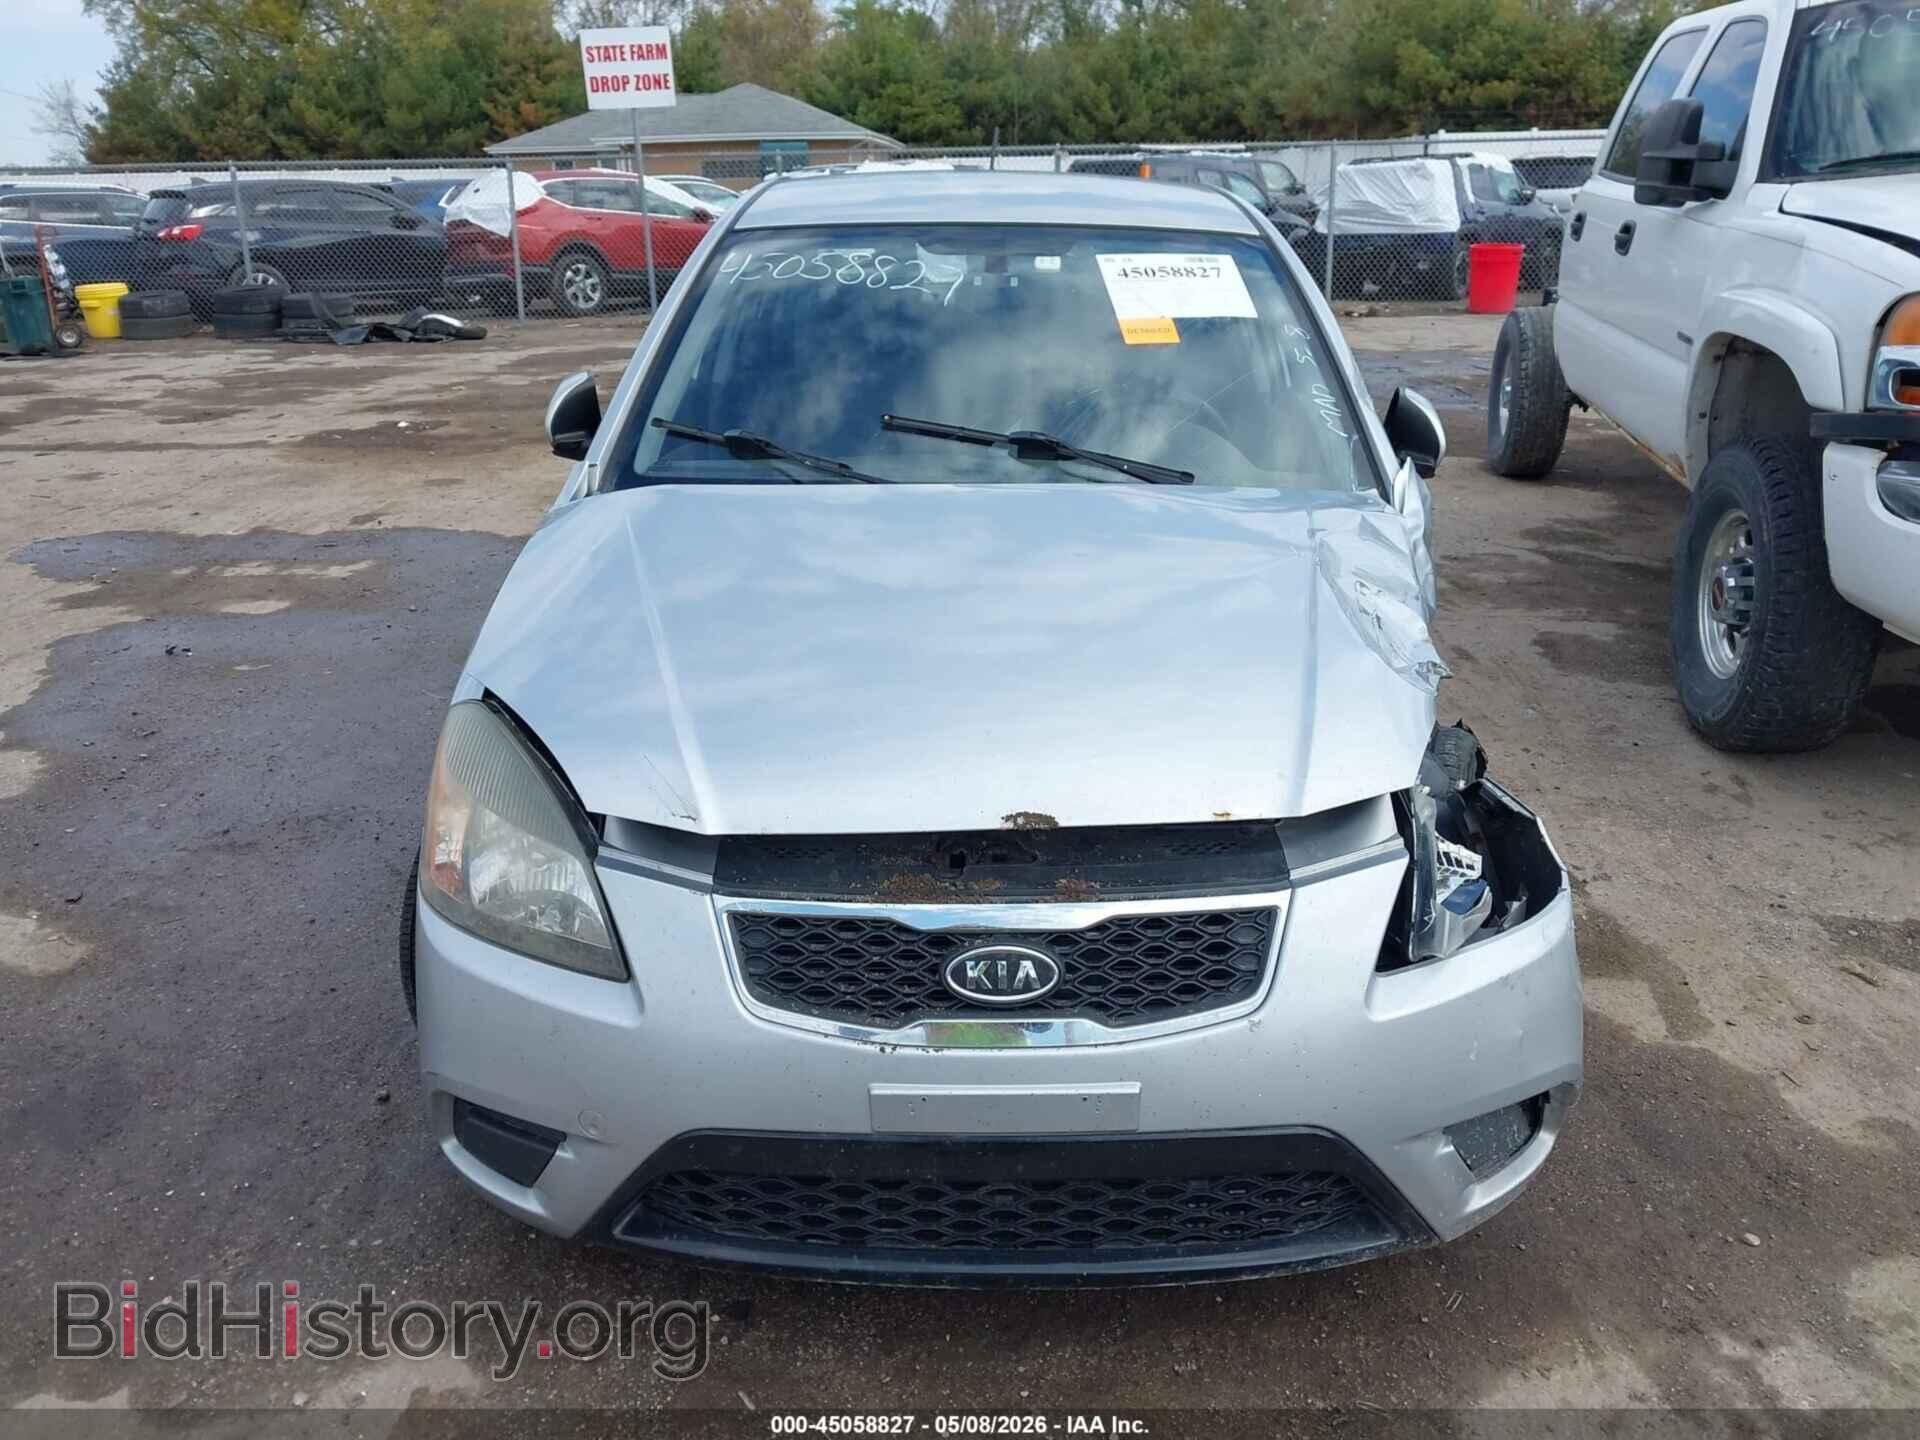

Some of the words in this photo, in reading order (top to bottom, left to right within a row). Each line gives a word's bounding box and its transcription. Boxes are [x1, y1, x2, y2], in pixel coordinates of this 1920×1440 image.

[585, 45, 627, 63] STATE
[629, 42, 668, 61] FARM
[589, 74, 630, 93] DROP
[634, 73, 671, 91] ZONE
[1117, 266, 1222, 279] 45058827
[965, 960, 1041, 990] KIA
